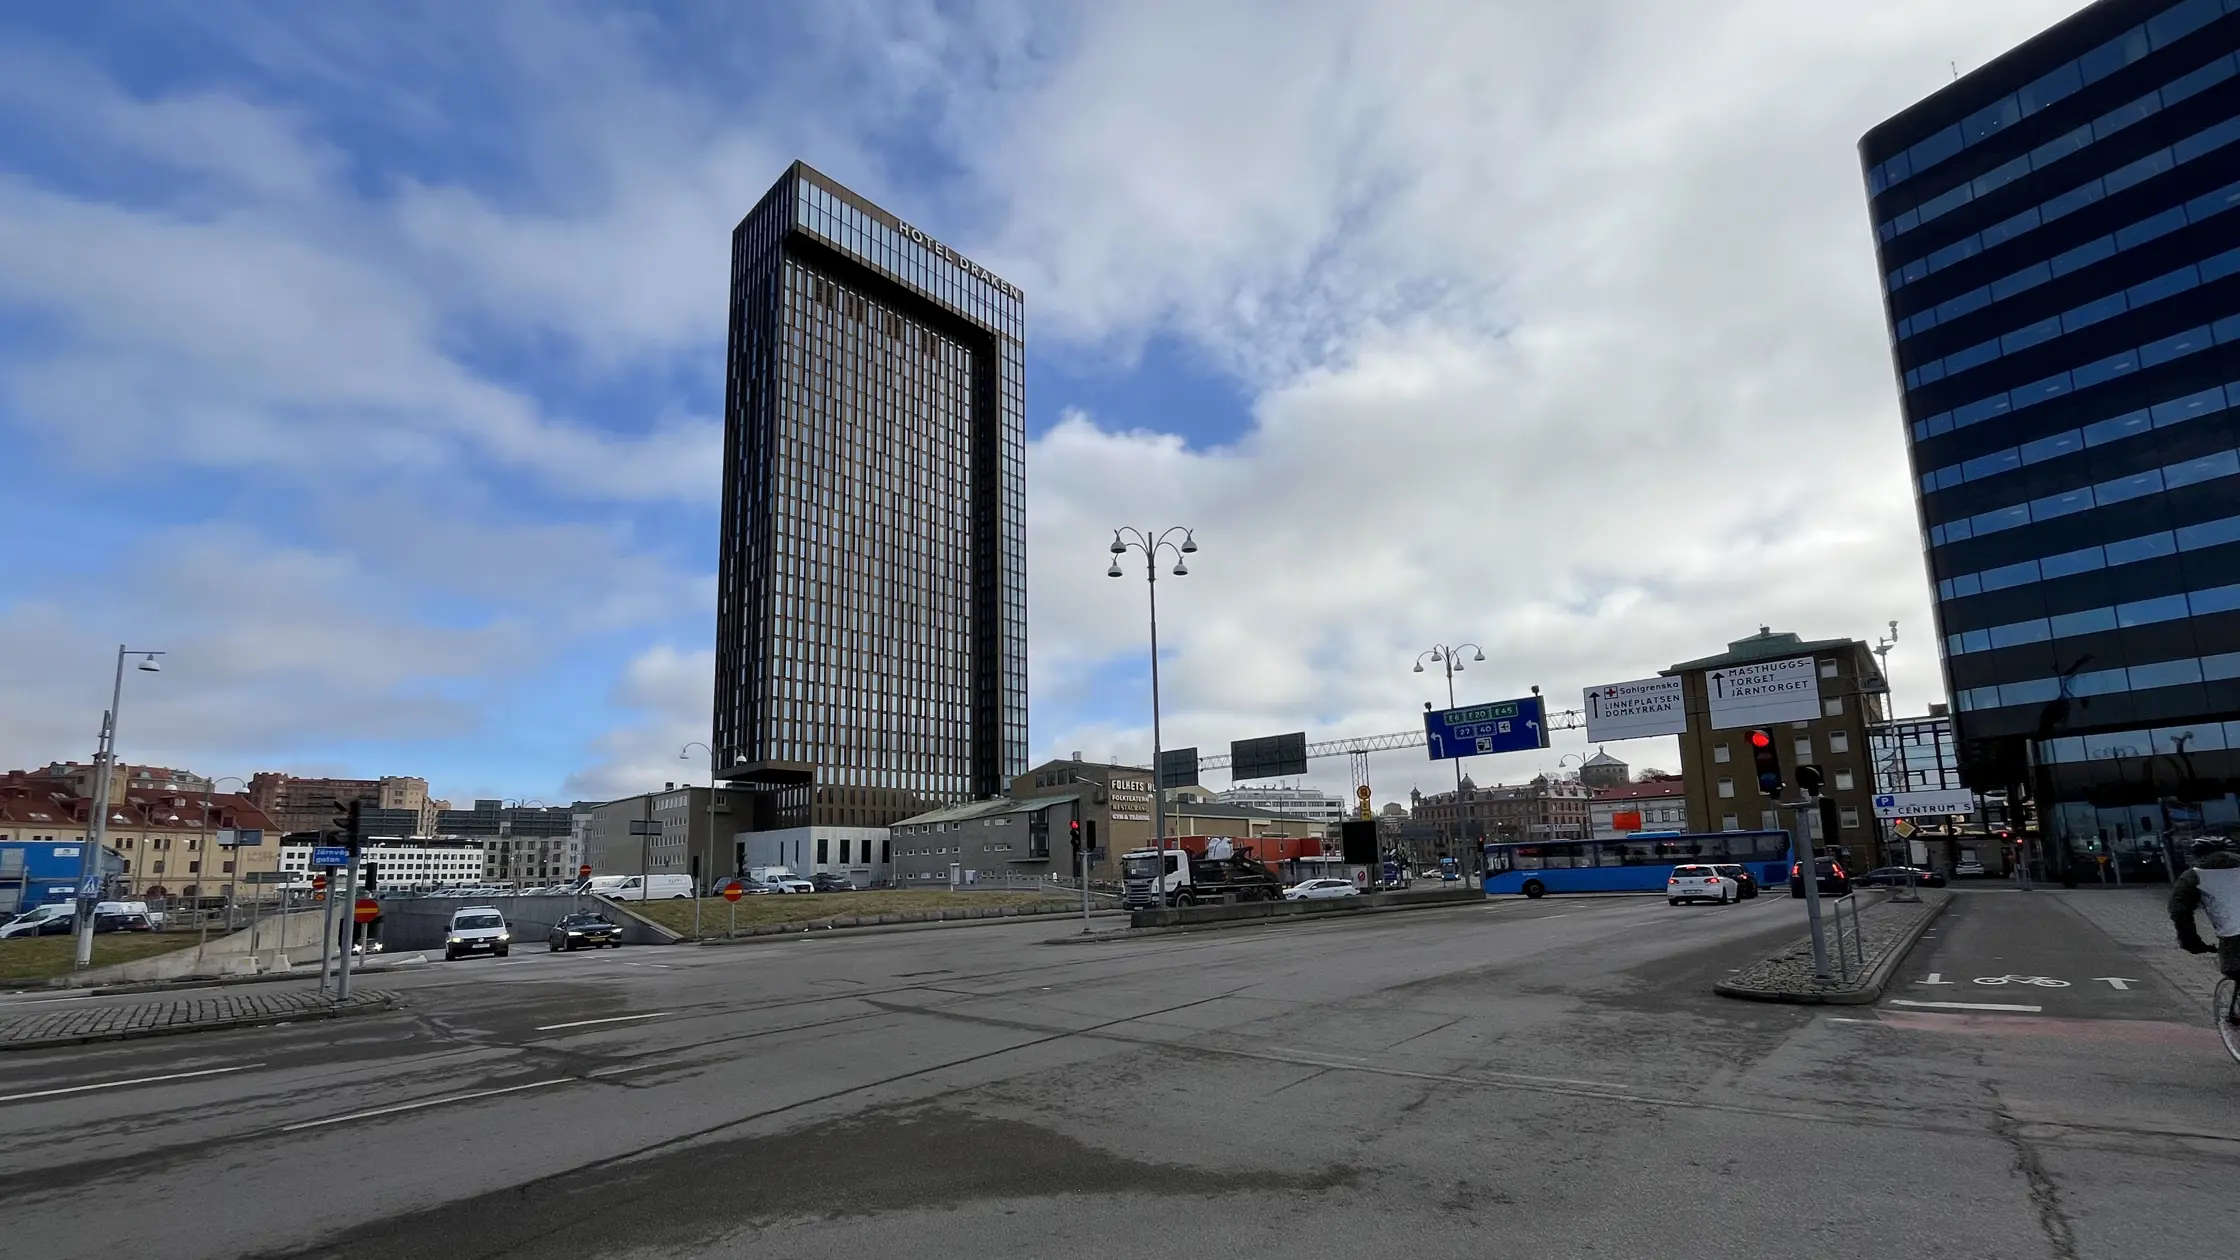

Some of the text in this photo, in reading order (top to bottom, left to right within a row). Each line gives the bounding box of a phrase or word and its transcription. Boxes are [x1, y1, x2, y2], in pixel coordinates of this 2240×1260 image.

[899, 221, 1019, 299] HOTEL DRAKEN
[1728, 659, 1811, 677] MASTHUGGS-
[1730, 673, 1775, 687] TORGET
[1619, 681, 1679, 695] Sahlgrenska
[1731, 680, 1808, 697] JÄRNTORGET
[1604, 694, 1680, 710] LINNÉPLATSEN
[1605, 703, 1671, 718] DOMKYRKAN
[1480, 725, 1492, 733] 40
[1111, 780, 1144, 791] FOLKETS
[1898, 803, 1971, 815] CENTRUM S
